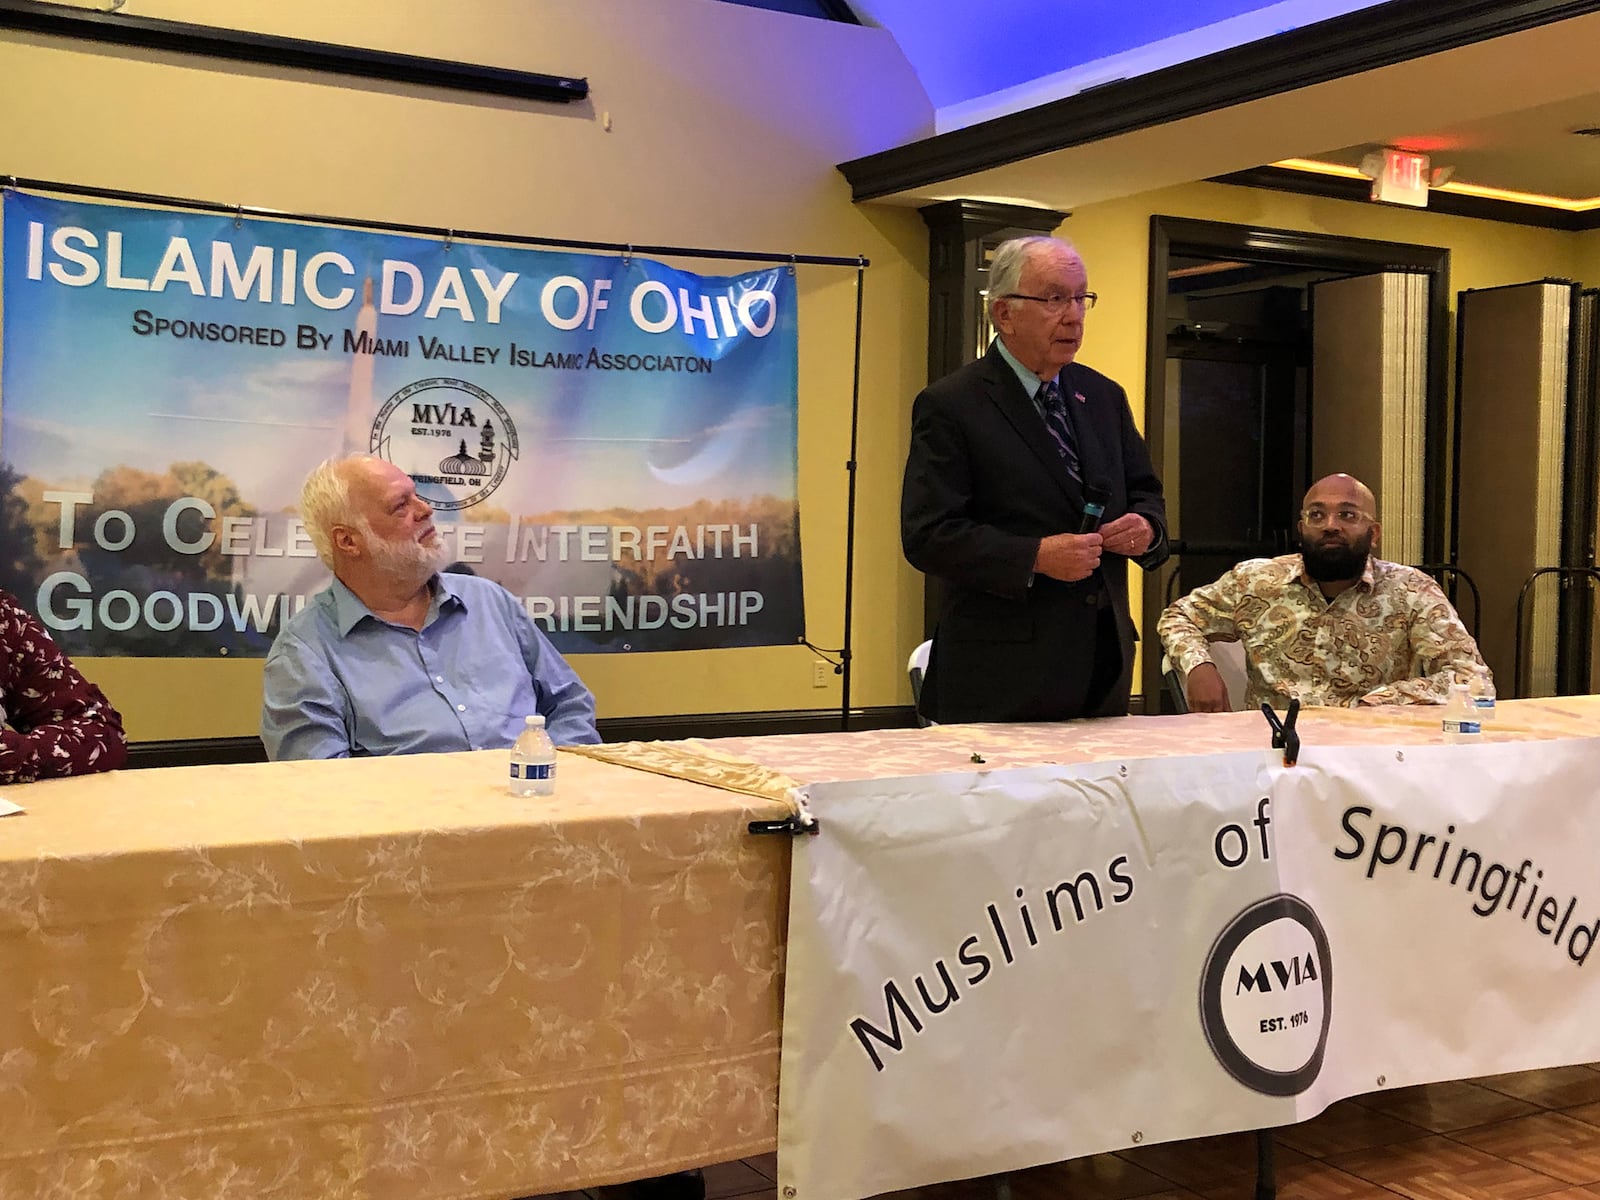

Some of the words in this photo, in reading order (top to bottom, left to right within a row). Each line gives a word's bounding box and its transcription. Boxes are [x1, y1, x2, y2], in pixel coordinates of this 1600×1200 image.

[27, 221, 355, 310] ISLAMIC
[380, 259, 519, 325] DAY
[540, 275, 612, 331] OF
[630, 281, 776, 339] OHIO
[132, 309, 286, 347] SPONSORED
[297, 324, 334, 350] BY
[343, 328, 409, 357] MIAMI
[418, 335, 500, 364] VALLEY
[510, 342, 584, 371] ISLAMIC
[585, 346, 712, 374] ASSOCIATON
[410, 402, 478, 427] MVIA
[409, 474, 467, 487] PRINGFIELD,
[42, 490, 136, 552] TO
[505, 513, 759, 563] INTERFAITH
[517, 590, 764, 633] RIENDSHIP
[849, 855, 1134, 1072] Muslims
[1214, 798, 1271, 868] of
[1334, 806, 1600, 967] Springfield
[1236, 951, 1319, 996] MVIA
[1260, 1017, 1288, 1033] EST.
[1289, 1010, 1309, 1028] 1976
